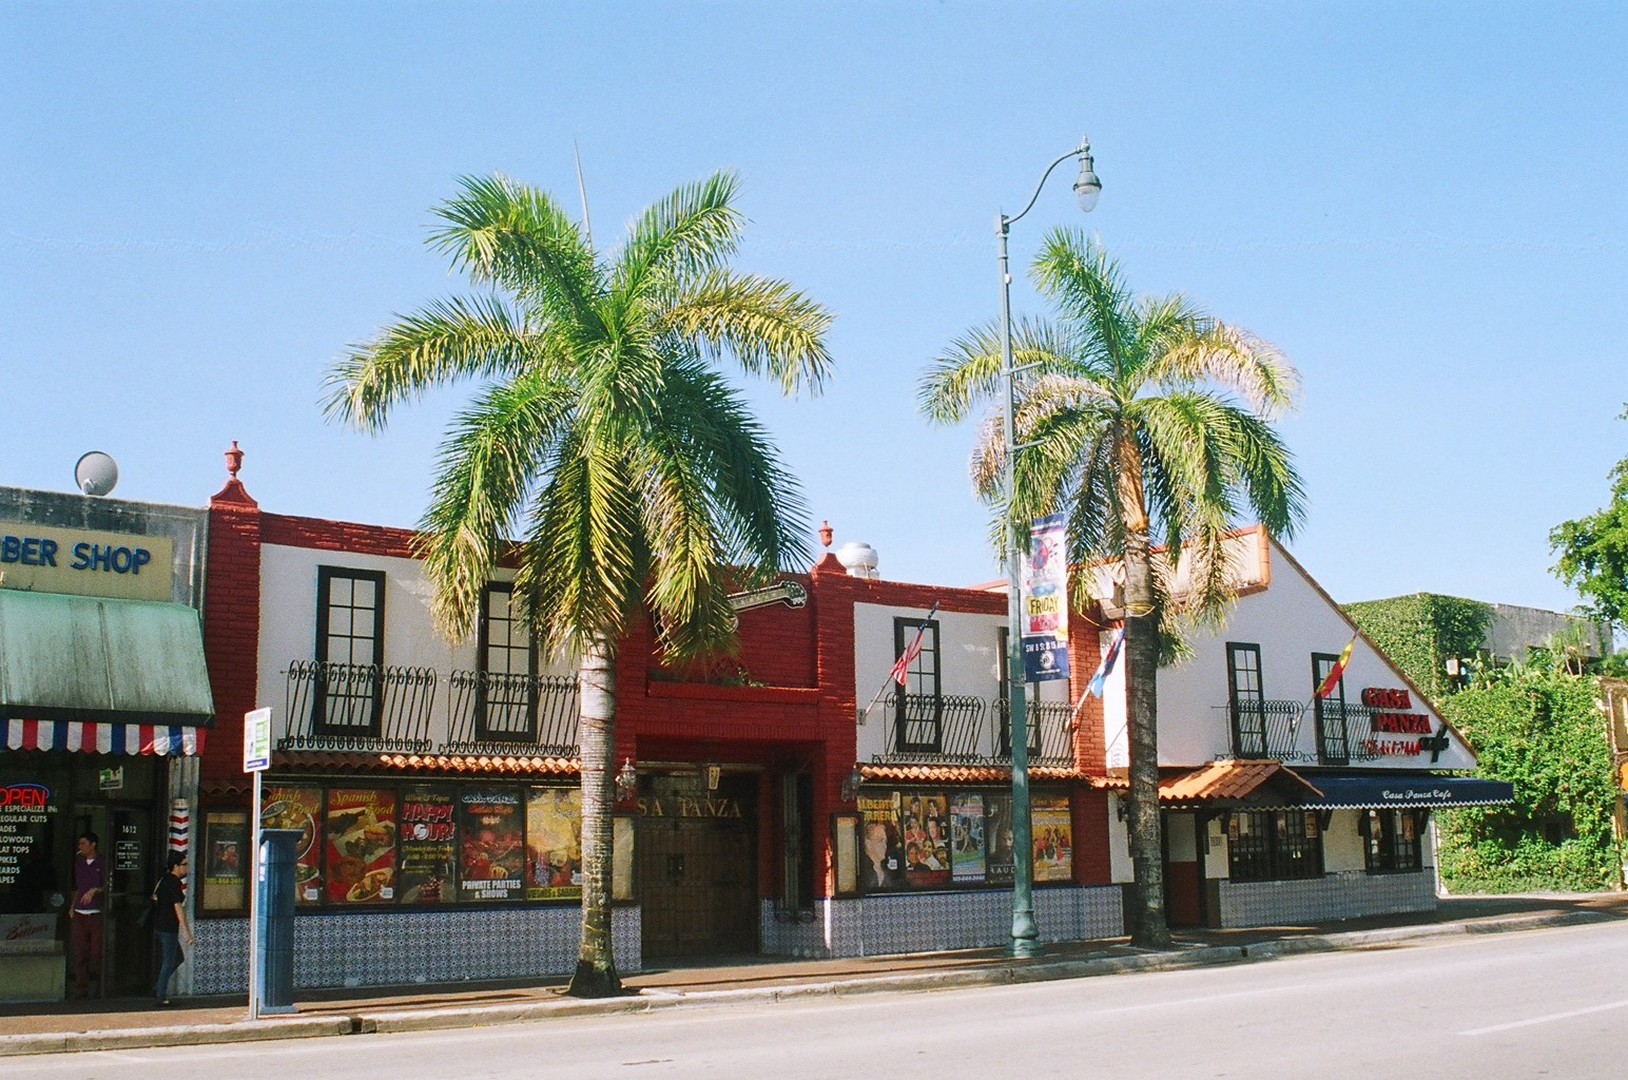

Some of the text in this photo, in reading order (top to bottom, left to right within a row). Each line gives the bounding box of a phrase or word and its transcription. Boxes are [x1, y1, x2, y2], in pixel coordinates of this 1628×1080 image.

[1, 535, 151, 575] BER SHOP
[1030, 597, 1058, 615] FRIDAY
[1025, 644, 1035, 653] SW
[1361, 687, 1412, 709] CASA
[1370, 712, 1432, 734] PANZA
[0, 788, 46, 806] OPEN
[330, 790, 378, 806] Spanish
[1382, 790, 1404, 800] Casa
[1405, 790, 1432, 799] Panza
[5, 805, 45, 813] ESPECIALIZE
[365, 803, 395, 816] Food
[401, 803, 454, 823] HAPPY
[680, 799, 743, 818] PANZA
[30, 815, 48, 823] CUTS
[122, 825, 137, 834] 1612
[401, 822, 456, 841] HOUR!
[12, 846, 30, 854] TOPS
[462, 879, 522, 890] PRIVATE PARTIES
[475, 889, 508, 899] & SHOWS
